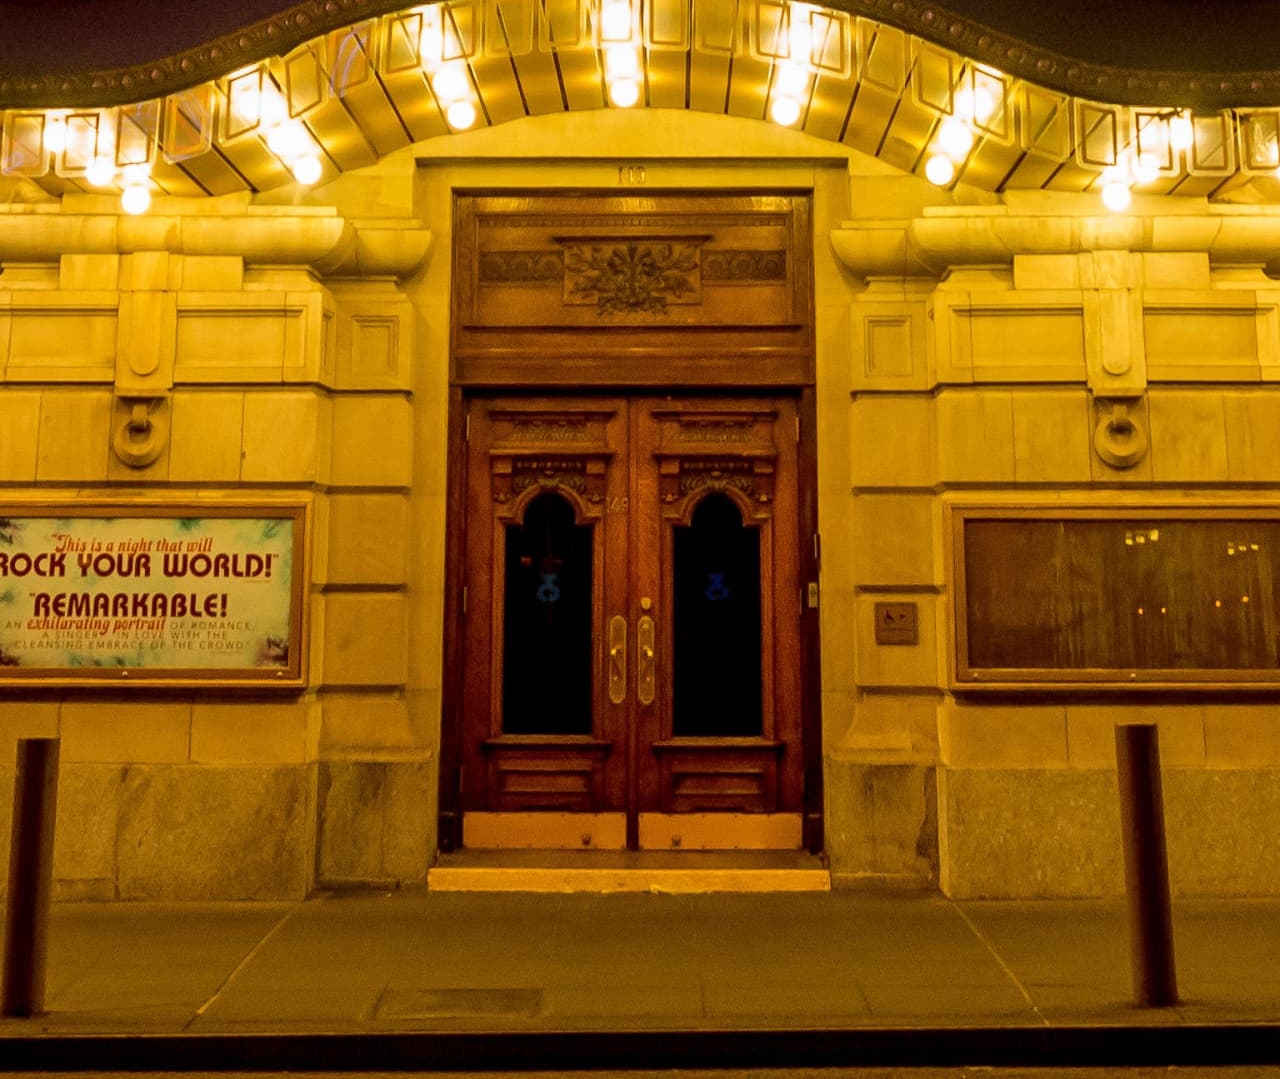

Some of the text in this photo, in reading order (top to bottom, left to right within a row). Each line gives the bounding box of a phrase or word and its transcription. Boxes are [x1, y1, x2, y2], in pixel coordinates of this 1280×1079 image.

[91, 537, 102, 552] is
[106, 541, 114, 552] a
[119, 537, 153, 555] night
[156, 537, 183, 552] that
[186, 537, 213, 552] will
[77, 553, 151, 577] YOUR
[27, 617, 110, 635] exhilarating
[112, 617, 166, 633] portrait
[169, 622, 185, 631] OF
[42, 631, 50, 639] A
[135, 631, 163, 640] LOVE
[170, 631, 200, 640] WITH
[206, 631, 226, 640] THE
[14, 640, 82, 649] CLEANSING
[88, 640, 144, 649] EMBRACE
[150, 641, 165, 650] OF
[172, 641, 192, 650] THE
